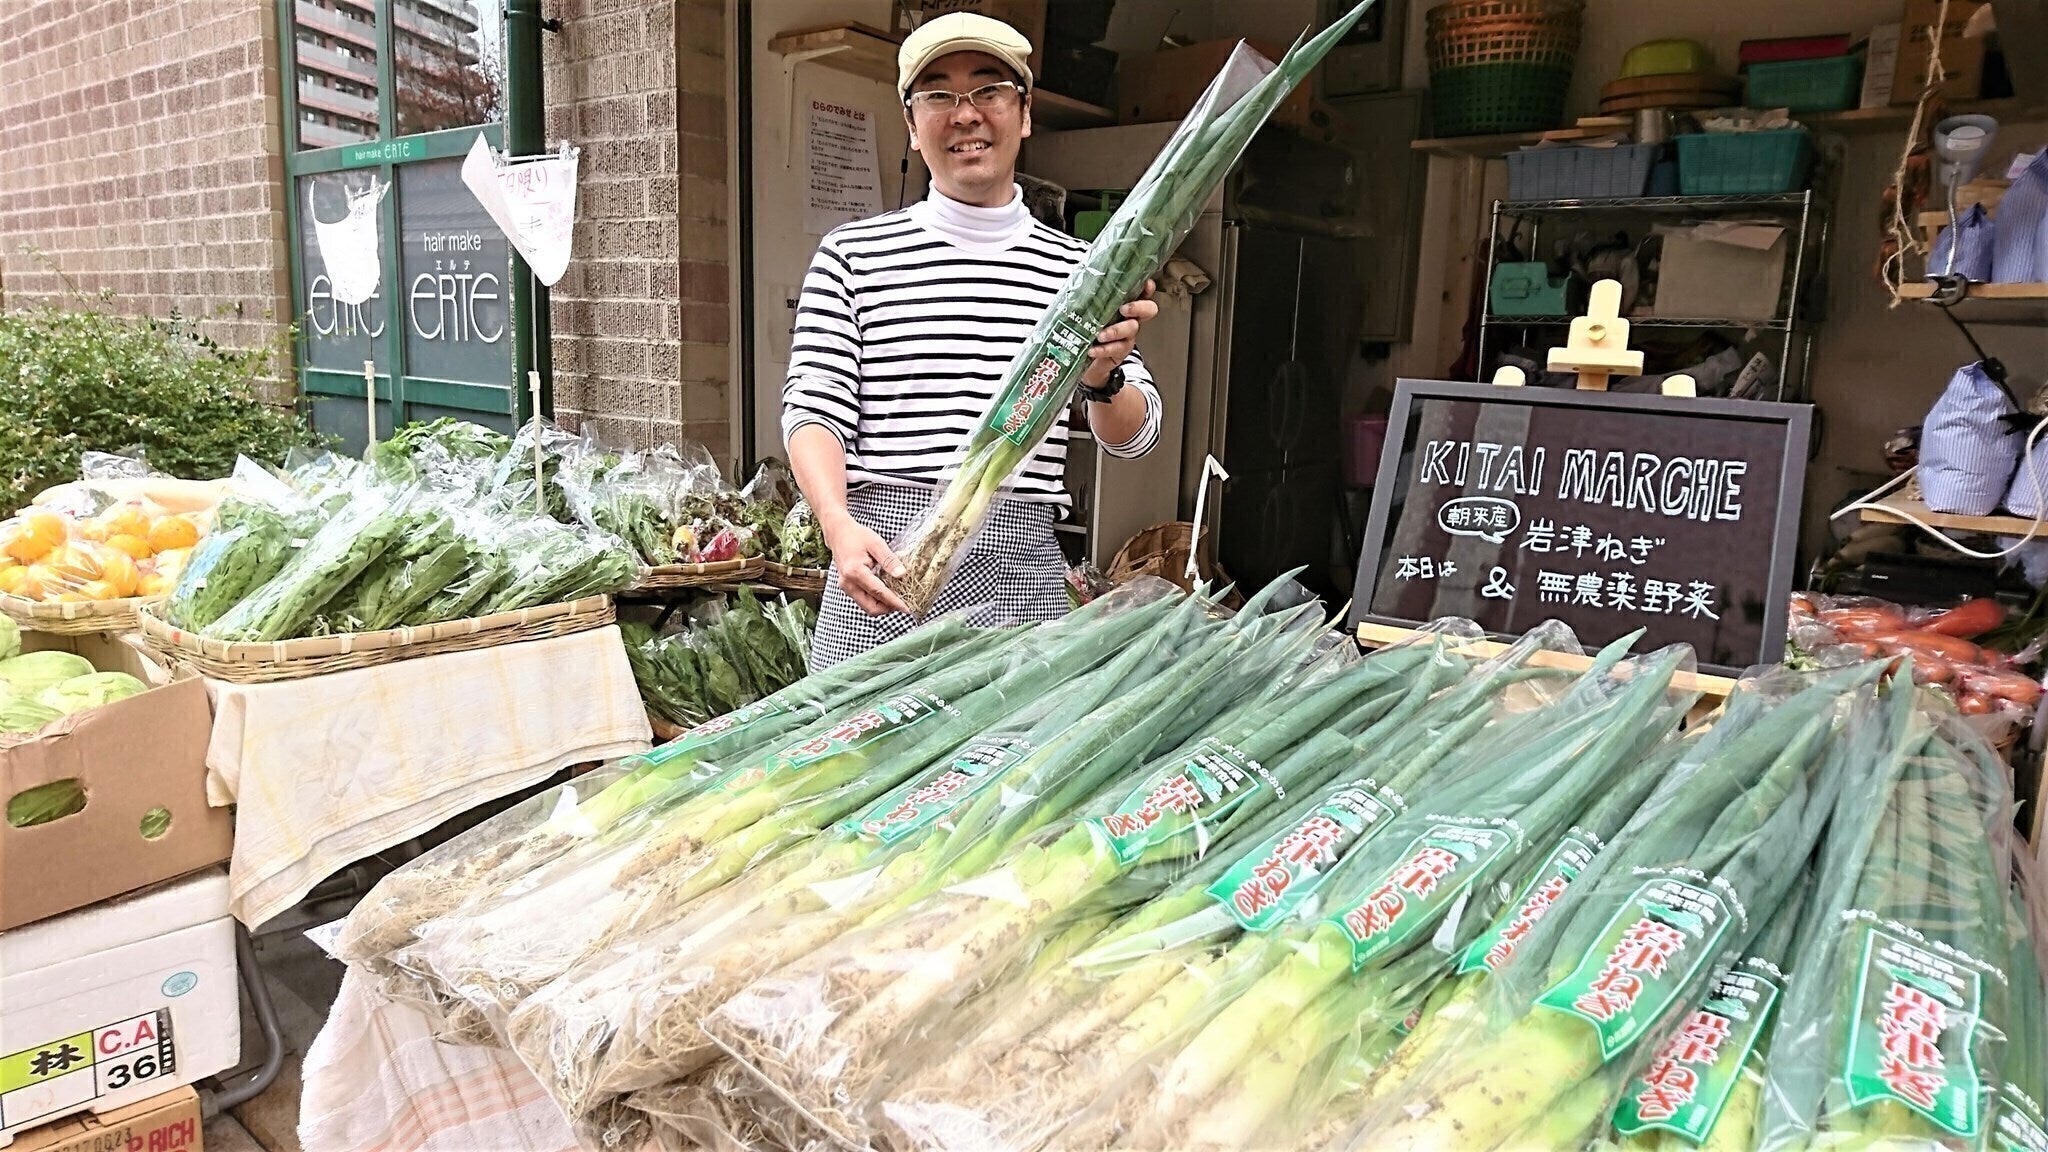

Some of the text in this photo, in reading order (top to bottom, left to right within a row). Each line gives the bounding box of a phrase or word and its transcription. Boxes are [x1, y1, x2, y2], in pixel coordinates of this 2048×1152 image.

[355, 150, 366, 160] hair
[366, 149, 382, 159] make
[424, 230, 481, 252] hair make
[436, 259, 471, 271] エルテ
[1003, 358, 1061, 435] 岩津ねぎ
[1420, 440, 1747, 522] KITAI MARCHE
[1446, 505, 1508, 528] 朝来産
[1519, 517, 1667, 566] 岩津ねぎ
[1395, 555, 1458, 580] 本日は
[1481, 565, 1720, 620] & 無農薬野菜
[1234, 816, 1345, 918] 岩津ねぎ
[1344, 847, 1460, 942] 岩津ねぎ
[1573, 917, 1687, 1022] 岩津ねぎ
[99, 1019, 156, 1055] C.A
[30, 1043, 85, 1077] 林
[106, 1054, 157, 1090] 36
[1637, 1011, 1731, 1121] 岩津ねぎ
[148, 1117, 195, 1152] RICH
